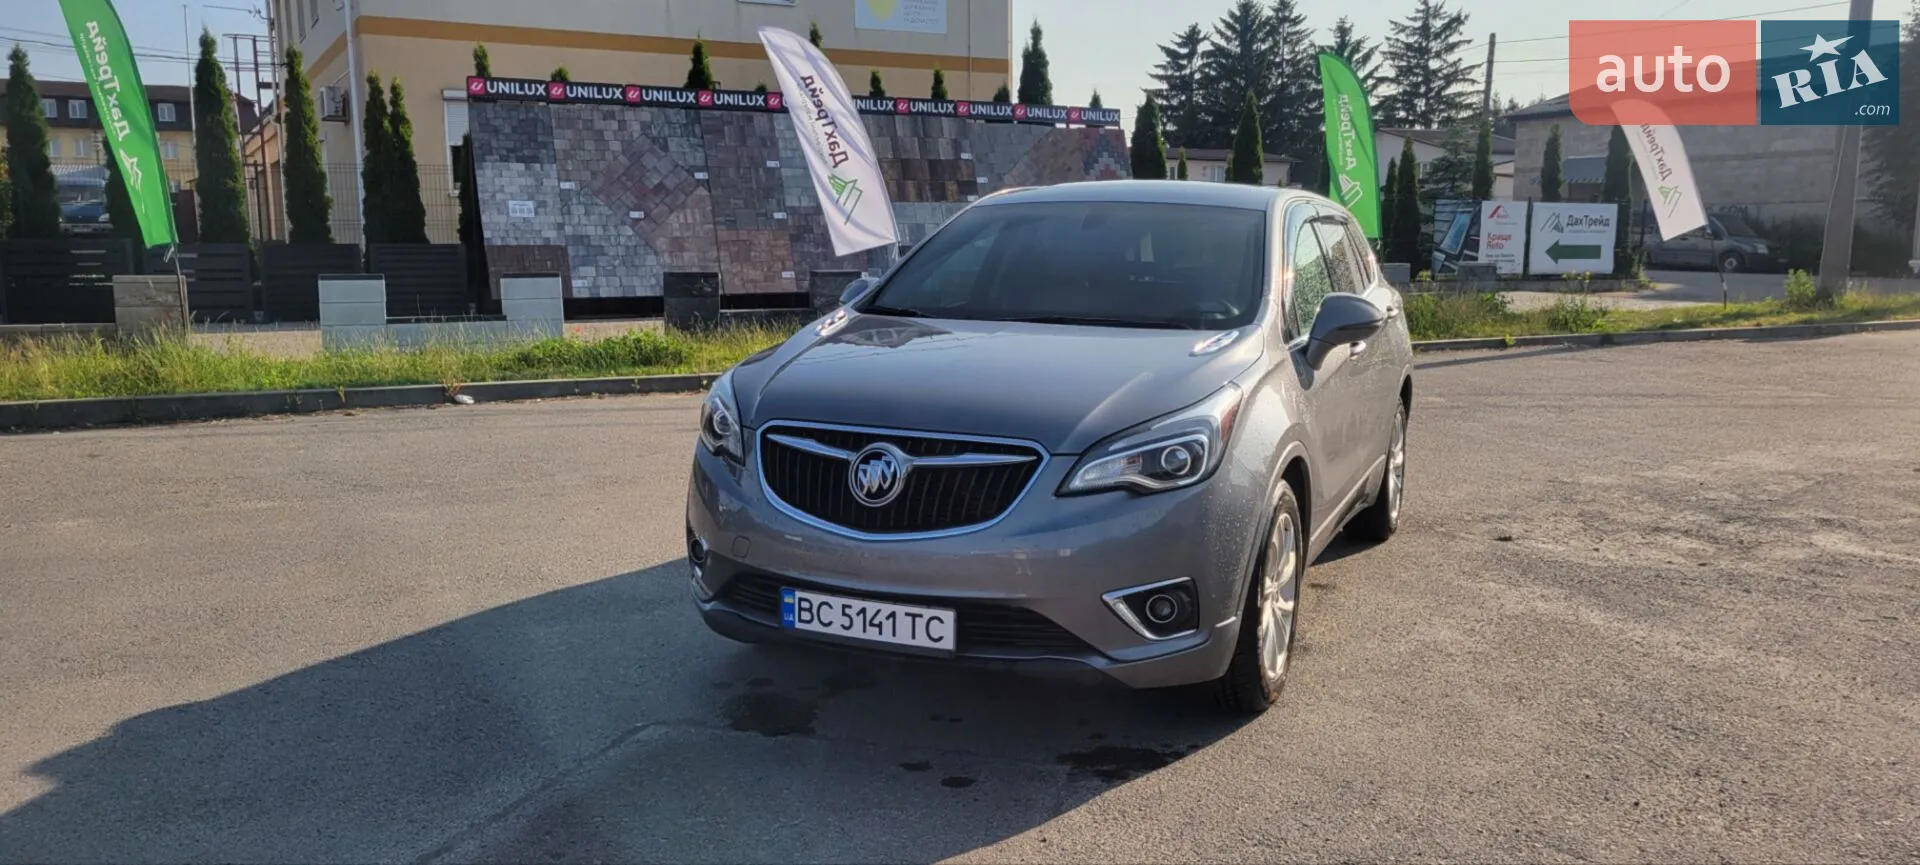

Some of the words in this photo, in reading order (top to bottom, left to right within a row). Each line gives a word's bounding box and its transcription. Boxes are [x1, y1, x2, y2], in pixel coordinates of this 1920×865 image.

[486, 80, 546, 97] UNILUX
[566, 85, 623, 100] UNILUX
[642, 89, 696, 104] UNILUX
[714, 93, 765, 107] UNILUX
[910, 102, 954, 114] UNILUX
[969, 105, 1012, 117] UNILUX
[1026, 107, 1067, 119] UNILUX
[1080, 110, 1120, 121] UNILUX
[1566, 215, 1610, 229] ДахТрейд
[797, 597, 834, 628] BC
[840, 604, 897, 638] 5141
[904, 611, 945, 643] TC
